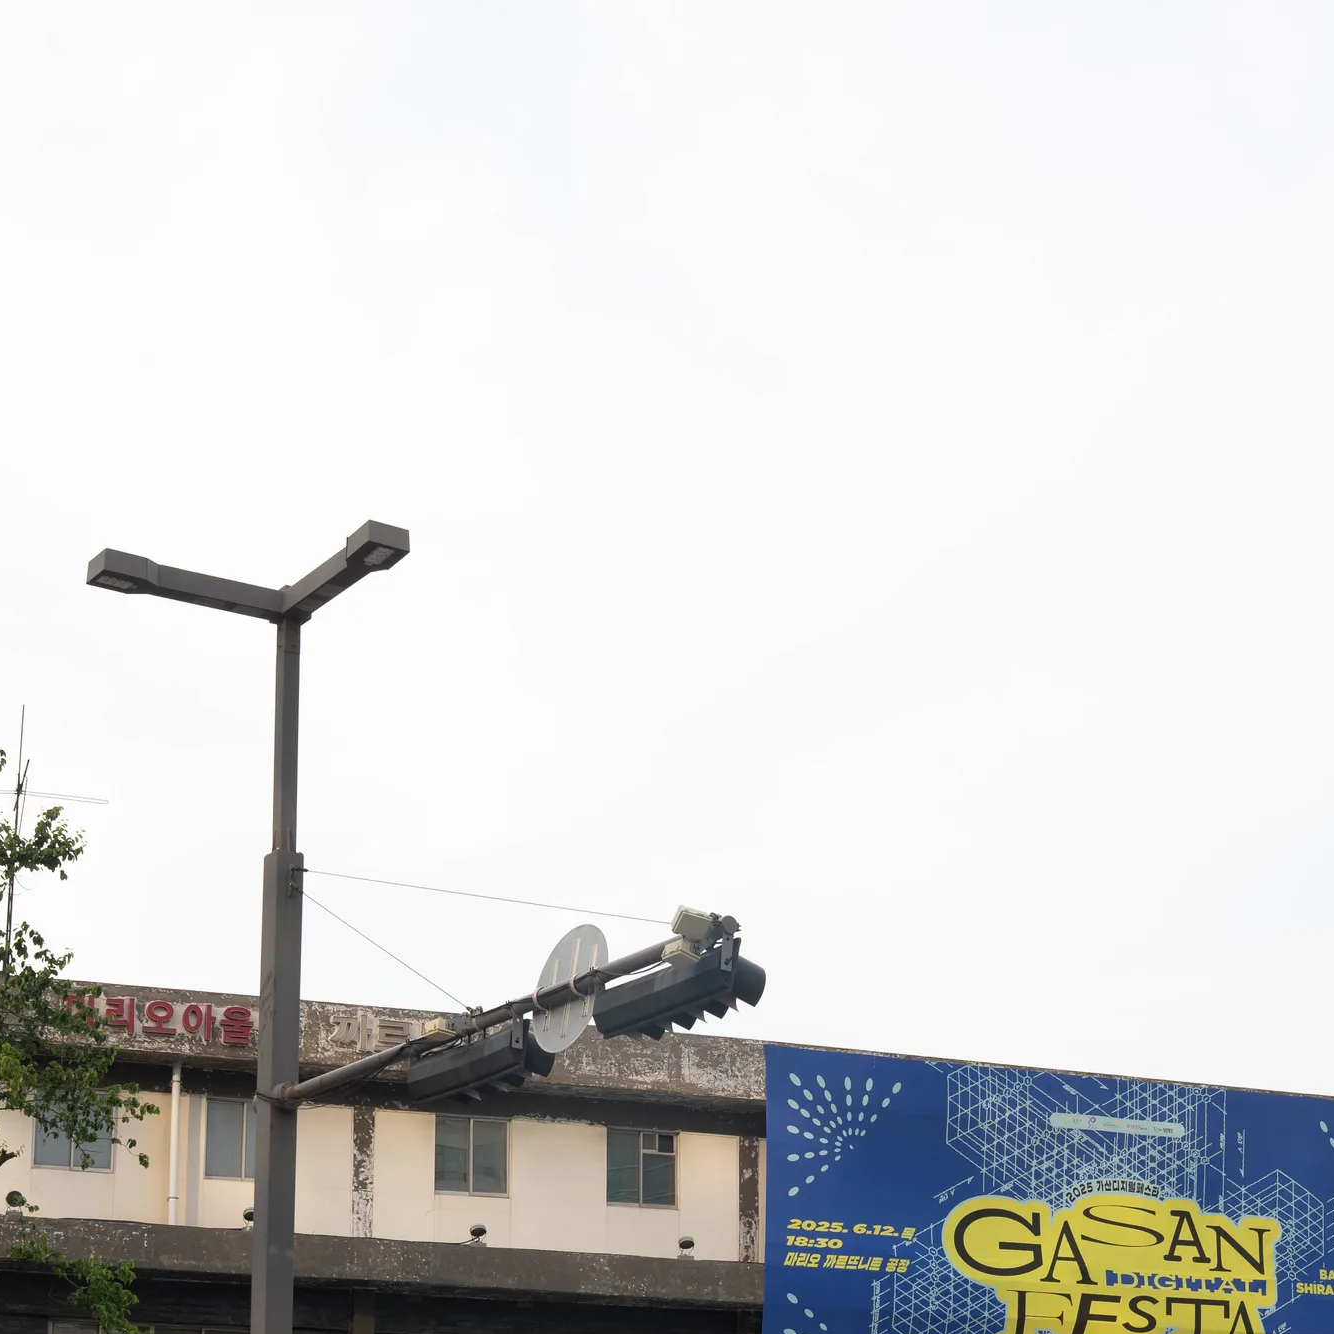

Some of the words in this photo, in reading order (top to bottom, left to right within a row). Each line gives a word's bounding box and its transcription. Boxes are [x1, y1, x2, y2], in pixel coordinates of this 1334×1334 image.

[1067, 1182, 1093, 1202] 2025
[1097, 1180, 1159, 1198] 가산디지털페스타
[787, 1218, 848, 1233] 2025.
[786, 1235, 843, 1249] 18:30
[954, 1205, 1271, 1285] GASAN
[783, 1252, 821, 1268] 마리오
[823, 1254, 884, 1271] 까르뜨니트
[885, 1258, 910, 1273] 공장
[1114, 1271, 1263, 1295] DIGITAL
